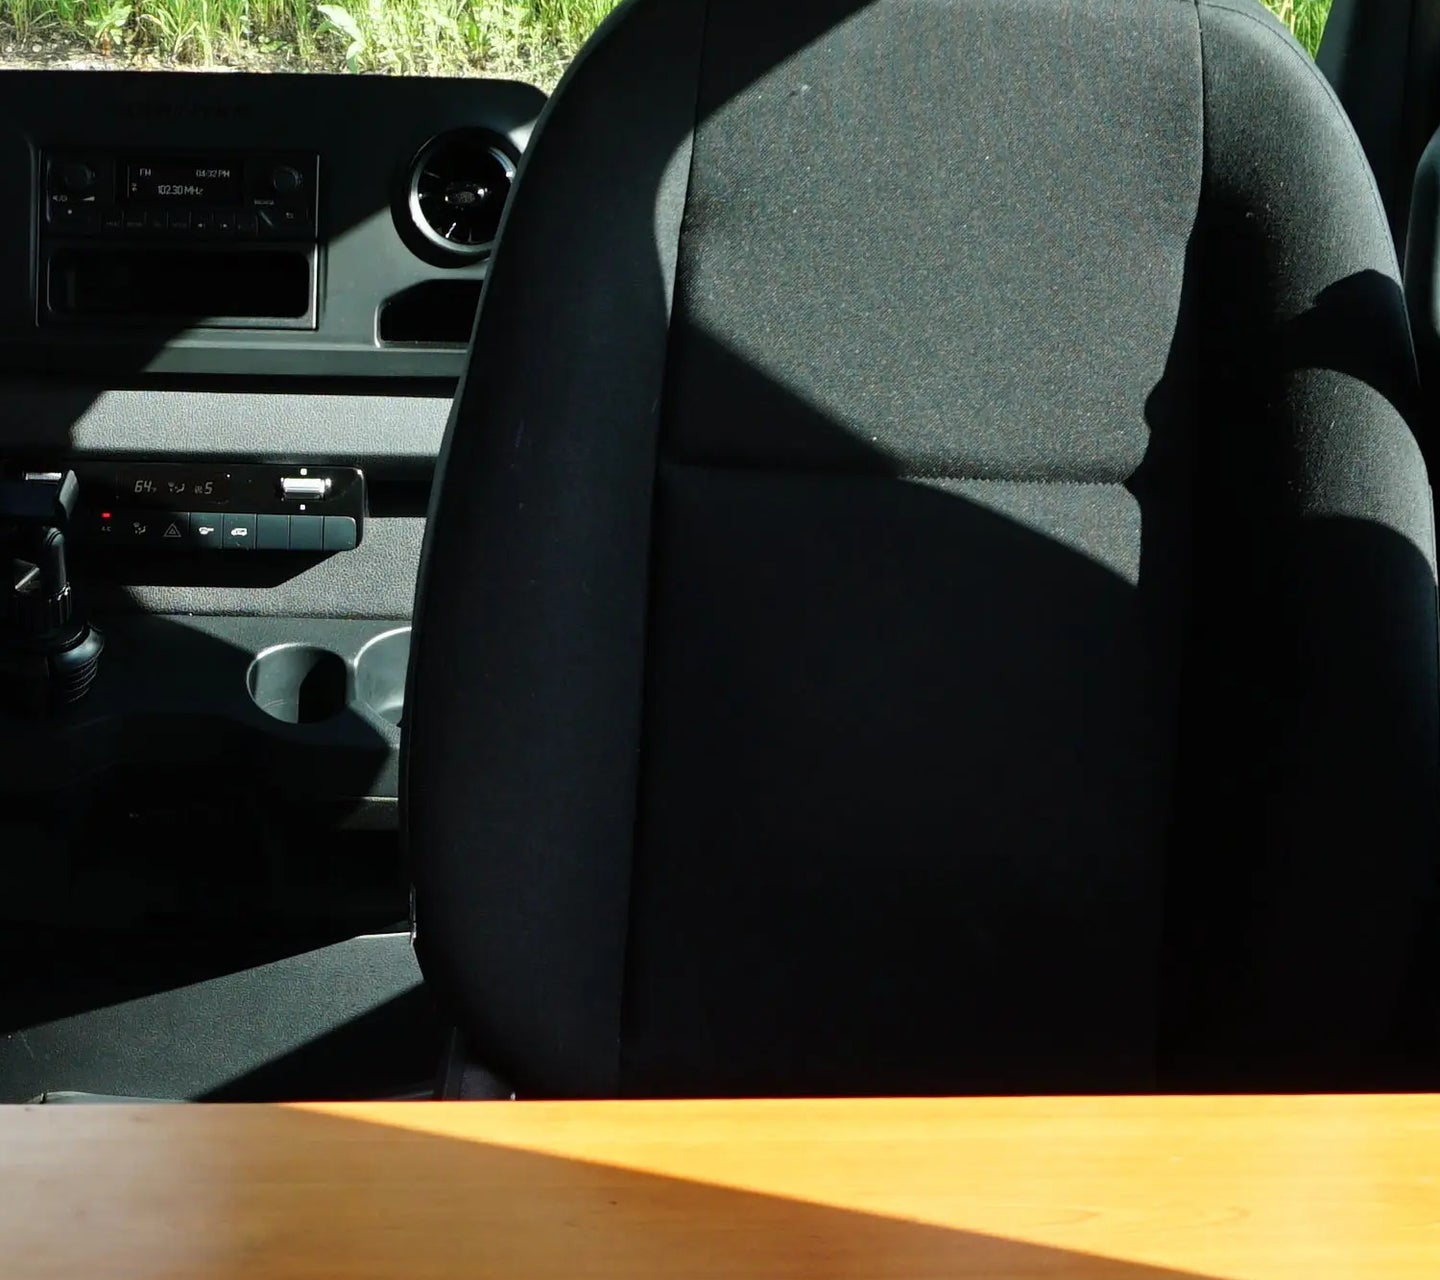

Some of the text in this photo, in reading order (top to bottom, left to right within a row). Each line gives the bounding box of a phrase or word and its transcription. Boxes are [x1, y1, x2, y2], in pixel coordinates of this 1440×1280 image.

[139, 167, 151, 178] FM
[217, 169, 231, 179] PM
[184, 184, 203, 197] MHz
